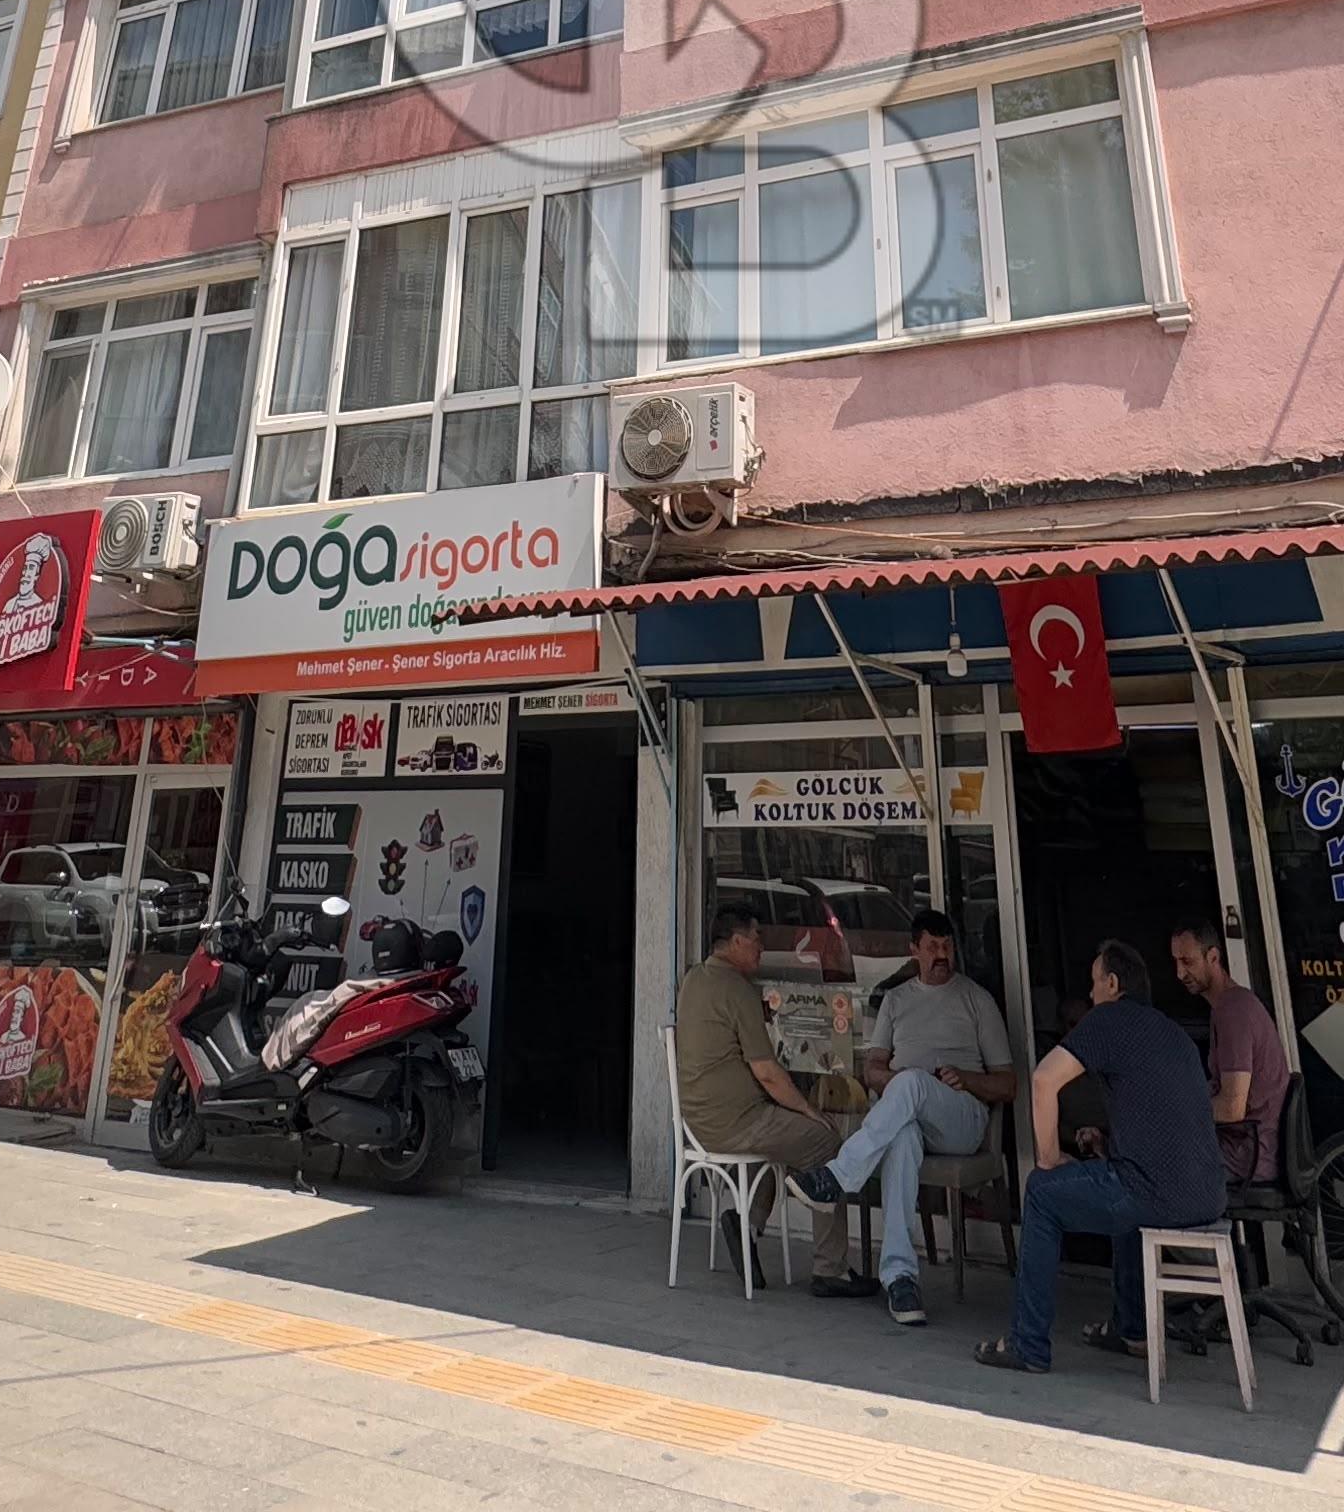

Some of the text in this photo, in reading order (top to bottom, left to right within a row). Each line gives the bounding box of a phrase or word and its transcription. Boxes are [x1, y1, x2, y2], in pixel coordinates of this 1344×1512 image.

[149, 499, 168, 556] BOSCH
[343, 600, 402, 643] güven
[9, 625, 48, 656] BABA
[296, 657, 345, 677] Mehmet
[346, 655, 384, 674] Şener
[392, 651, 430, 671] Şener
[483, 640, 537, 663] Aracılık
[407, 699, 502, 729] TRAFİK SİGORTASI
[523, 695, 557, 710] MEHMET
[296, 707, 333, 726] ZORUNLU
[295, 733, 329, 750] DEPREM
[288, 754, 330, 774] SİGORTASI
[796, 772, 884, 796] GÖLCÜK
[285, 807, 337, 839] TRAFİK
[754, 802, 836, 821] KOLTUK
[278, 860, 329, 889] KASKO
[786, 994, 828, 1007] ARMA
